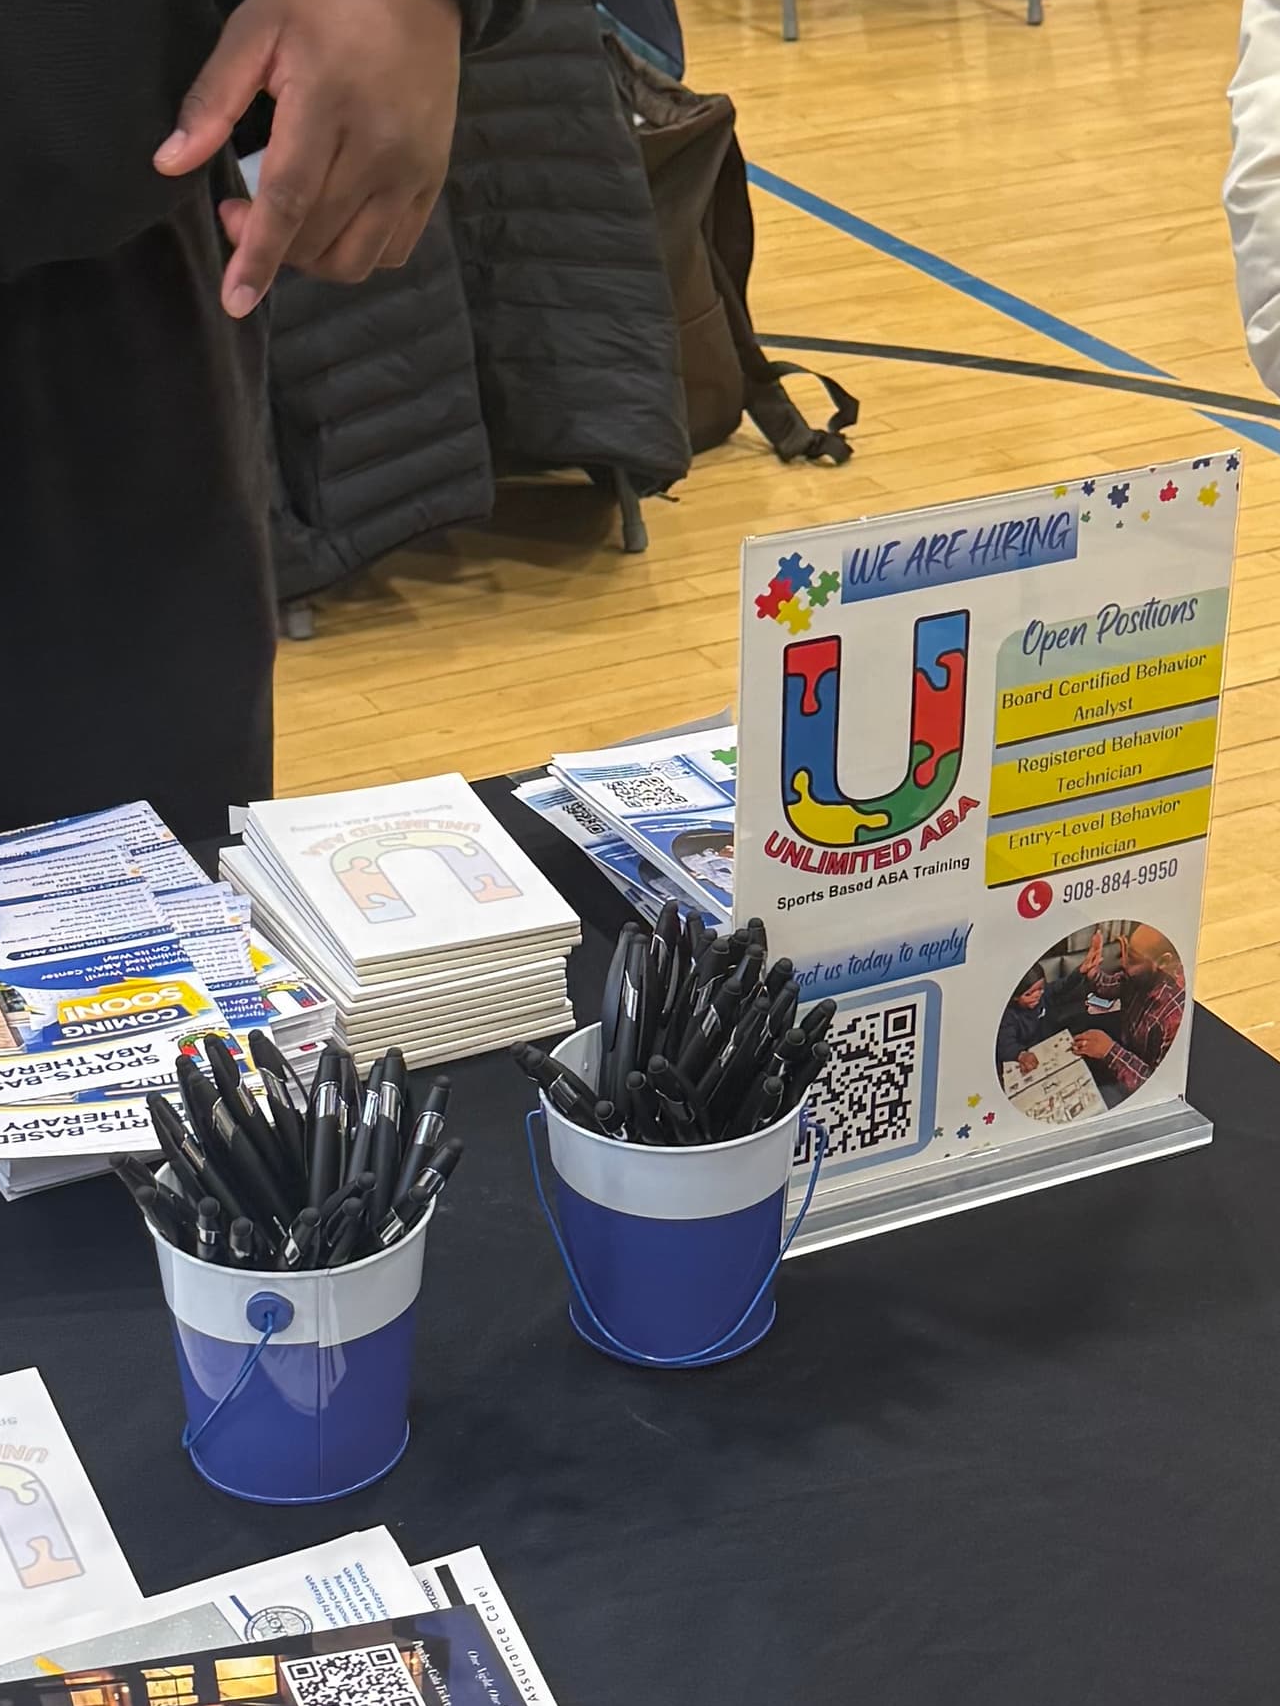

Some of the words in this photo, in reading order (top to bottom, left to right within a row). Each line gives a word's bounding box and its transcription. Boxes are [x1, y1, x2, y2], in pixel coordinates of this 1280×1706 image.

[847, 544, 898, 585] WE
[902, 530, 967, 575] ARE
[967, 510, 1073, 562] HIRING
[1018, 611, 1092, 668] Open
[1092, 590, 1202, 643] Positions
[1000, 683, 1054, 709] Board
[1056, 667, 1130, 696] Certified
[1134, 652, 1208, 680] Behavior
[1071, 696, 1134, 723] Analyst
[1015, 744, 1107, 776] Registered
[1110, 724, 1184, 752] Behavior
[1056, 762, 1143, 792] Technician
[764, 829, 911, 878] UNLIMITED
[919, 793, 982, 850] ABA
[1006, 815, 1106, 850] Entry-Level
[1109, 798, 1182, 826] Behavior
[1051, 836, 1137, 867] Technician
[775, 888, 825, 910] Sports
[827, 877, 873, 898] Based
[874, 868, 909, 887] ABA
[911, 854, 971, 880] Training
[1062, 859, 1179, 902] 908-884-9950
[123, 949, 186, 966] Unlimited
[151, 945, 169, 954] On
[823, 964, 843, 980] us
[845, 947, 894, 981] today
[896, 941, 913, 958] to
[917, 923, 977, 960] apply!
[40, 968, 82, 981] Center
[86, 962, 120, 973] ABA's
[125, 964, 143, 974] the
[61, 984, 185, 1022] SOON!
[60, 1006, 179, 1038] COMING
[89, 1042, 153, 1063] ABA
[1, 1106, 134, 1133] THERAPY
[493, 1624, 540, 1706] Assurance
